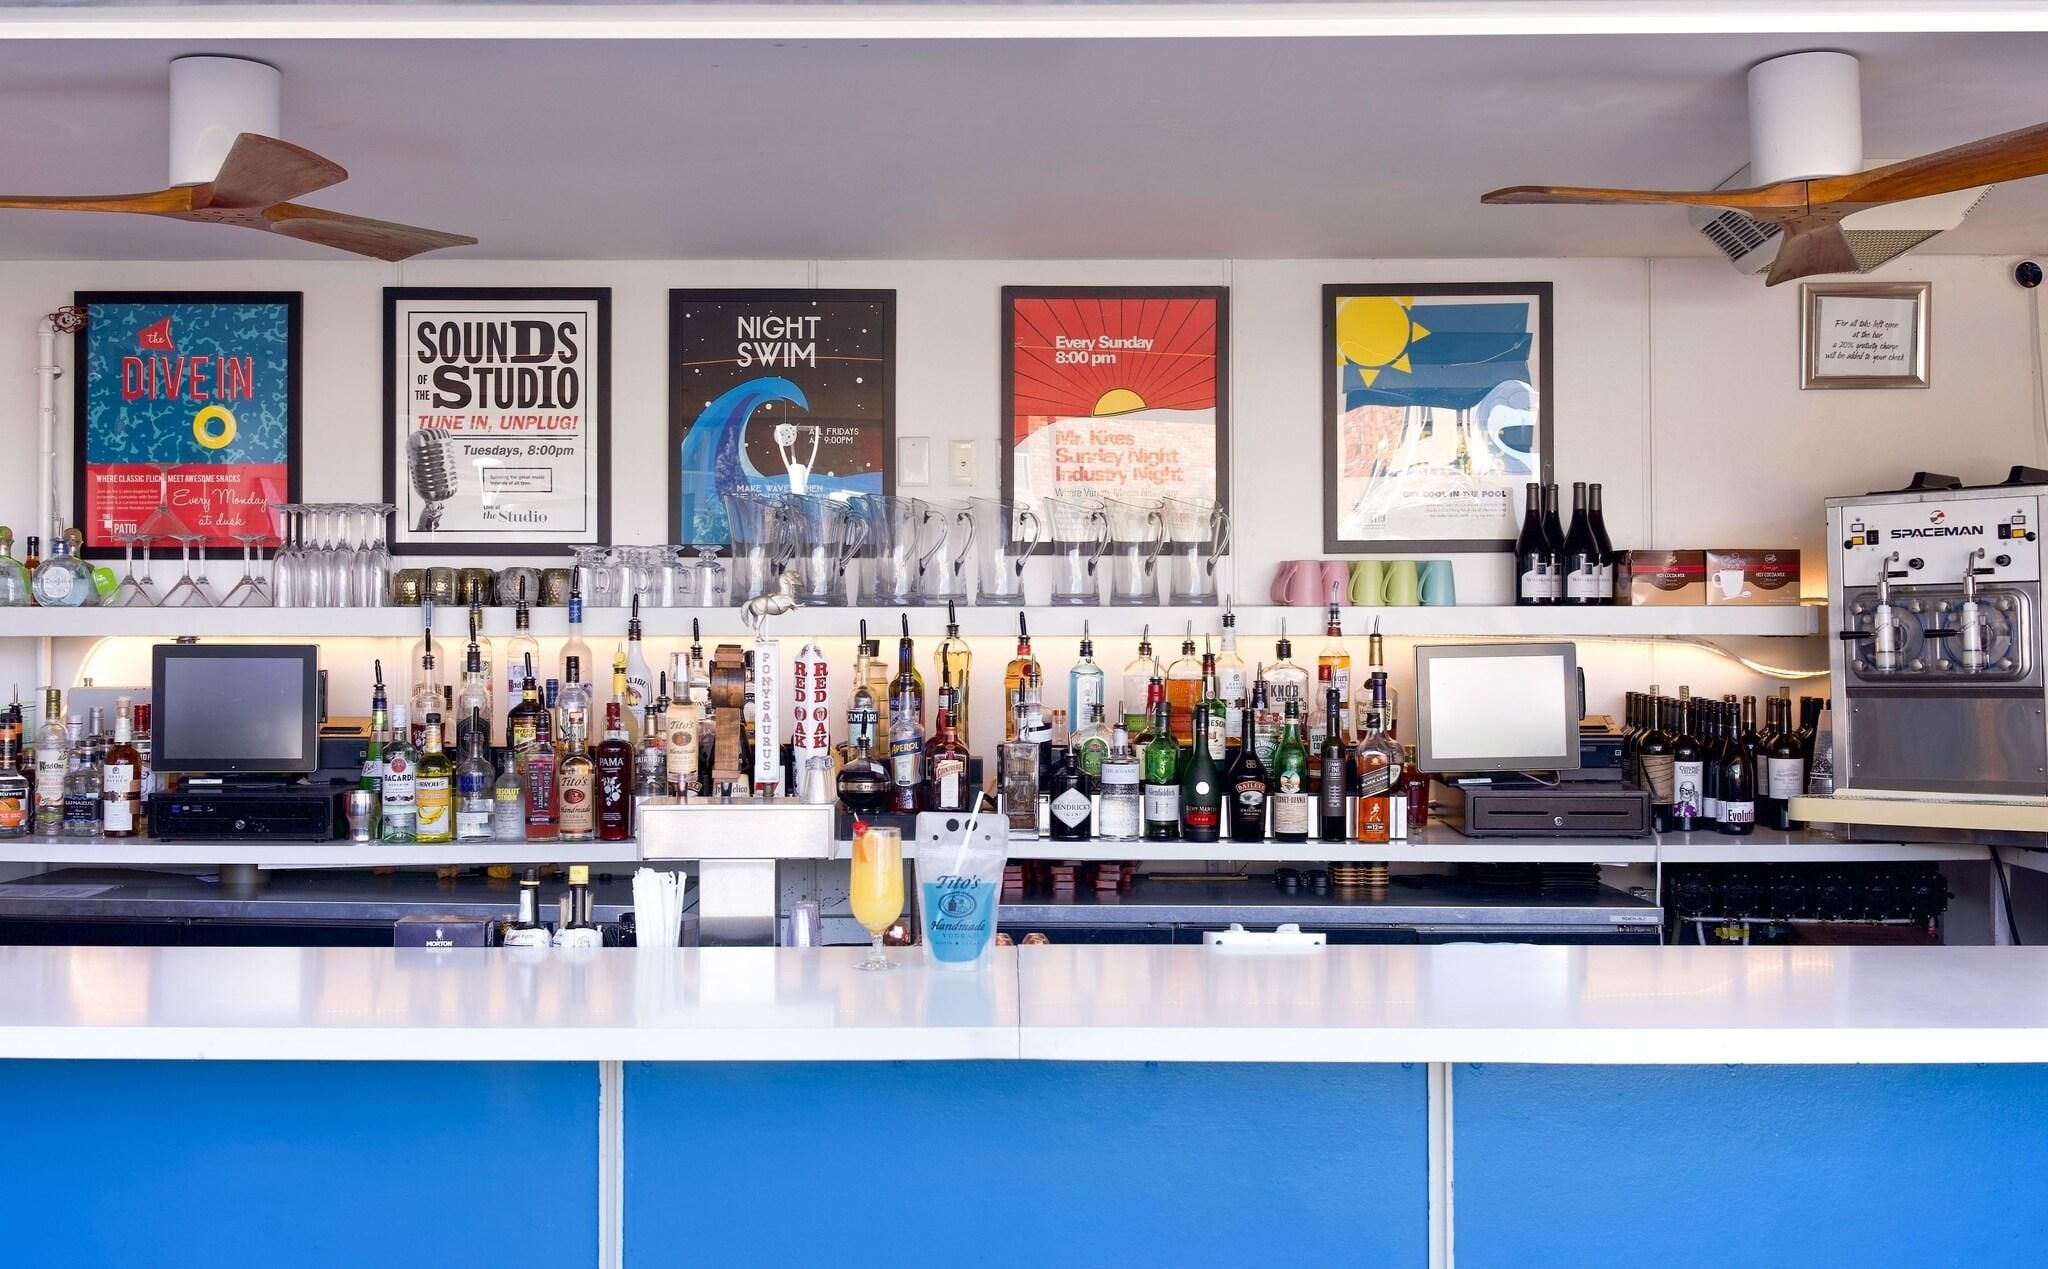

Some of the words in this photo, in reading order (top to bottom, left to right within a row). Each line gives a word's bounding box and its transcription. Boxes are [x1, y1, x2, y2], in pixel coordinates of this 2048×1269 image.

[738, 316, 821, 339] NIGHT
[146, 332, 164, 344] the
[417, 320, 578, 364] SOUNDS
[1056, 336, 1095, 351] Every
[1099, 336, 1153, 351] Sunday
[737, 342, 816, 368] SWIM
[1056, 352, 1088, 364] 8:00
[1092, 354, 1116, 366] pm
[417, 374, 428, 384] OF
[432, 365, 579, 409] STUDIO
[415, 390, 430, 400] THE
[418, 416, 465, 430] TUNE
[470, 416, 492, 432] IN,
[500, 416, 579, 430] UNPLUG!
[463, 445, 523, 457] Tuesdays,
[527, 445, 574, 457] 8:00pm
[1056, 448, 1123, 466] Sunday
[1128, 448, 1178, 466] Night
[1056, 466, 1126, 485] Industry
[1133, 466, 1184, 485] Night
[172, 489, 210, 511] Every
[212, 488, 268, 511] Monday
[199, 515, 212, 526] at
[215, 513, 246, 526] dusk
[483, 511, 496, 519] the
[498, 510, 547, 522] Studio
[114, 524, 136, 534] PATIO
[1890, 526, 1984, 539] SPACEMAN
[794, 662, 807, 702] RED
[813, 662, 828, 703] RED
[1271, 685, 1298, 697] KNOB
[670, 720, 694, 730] Tito's
[794, 706, 807, 749] OAK
[813, 706, 827, 749] OAK
[892, 742, 919, 754] APEROL
[599, 758, 624, 766] PAMA
[561, 776, 588, 786] Tito's
[936, 875, 981, 889] Tito's
[930, 918, 985, 931] Handmade
